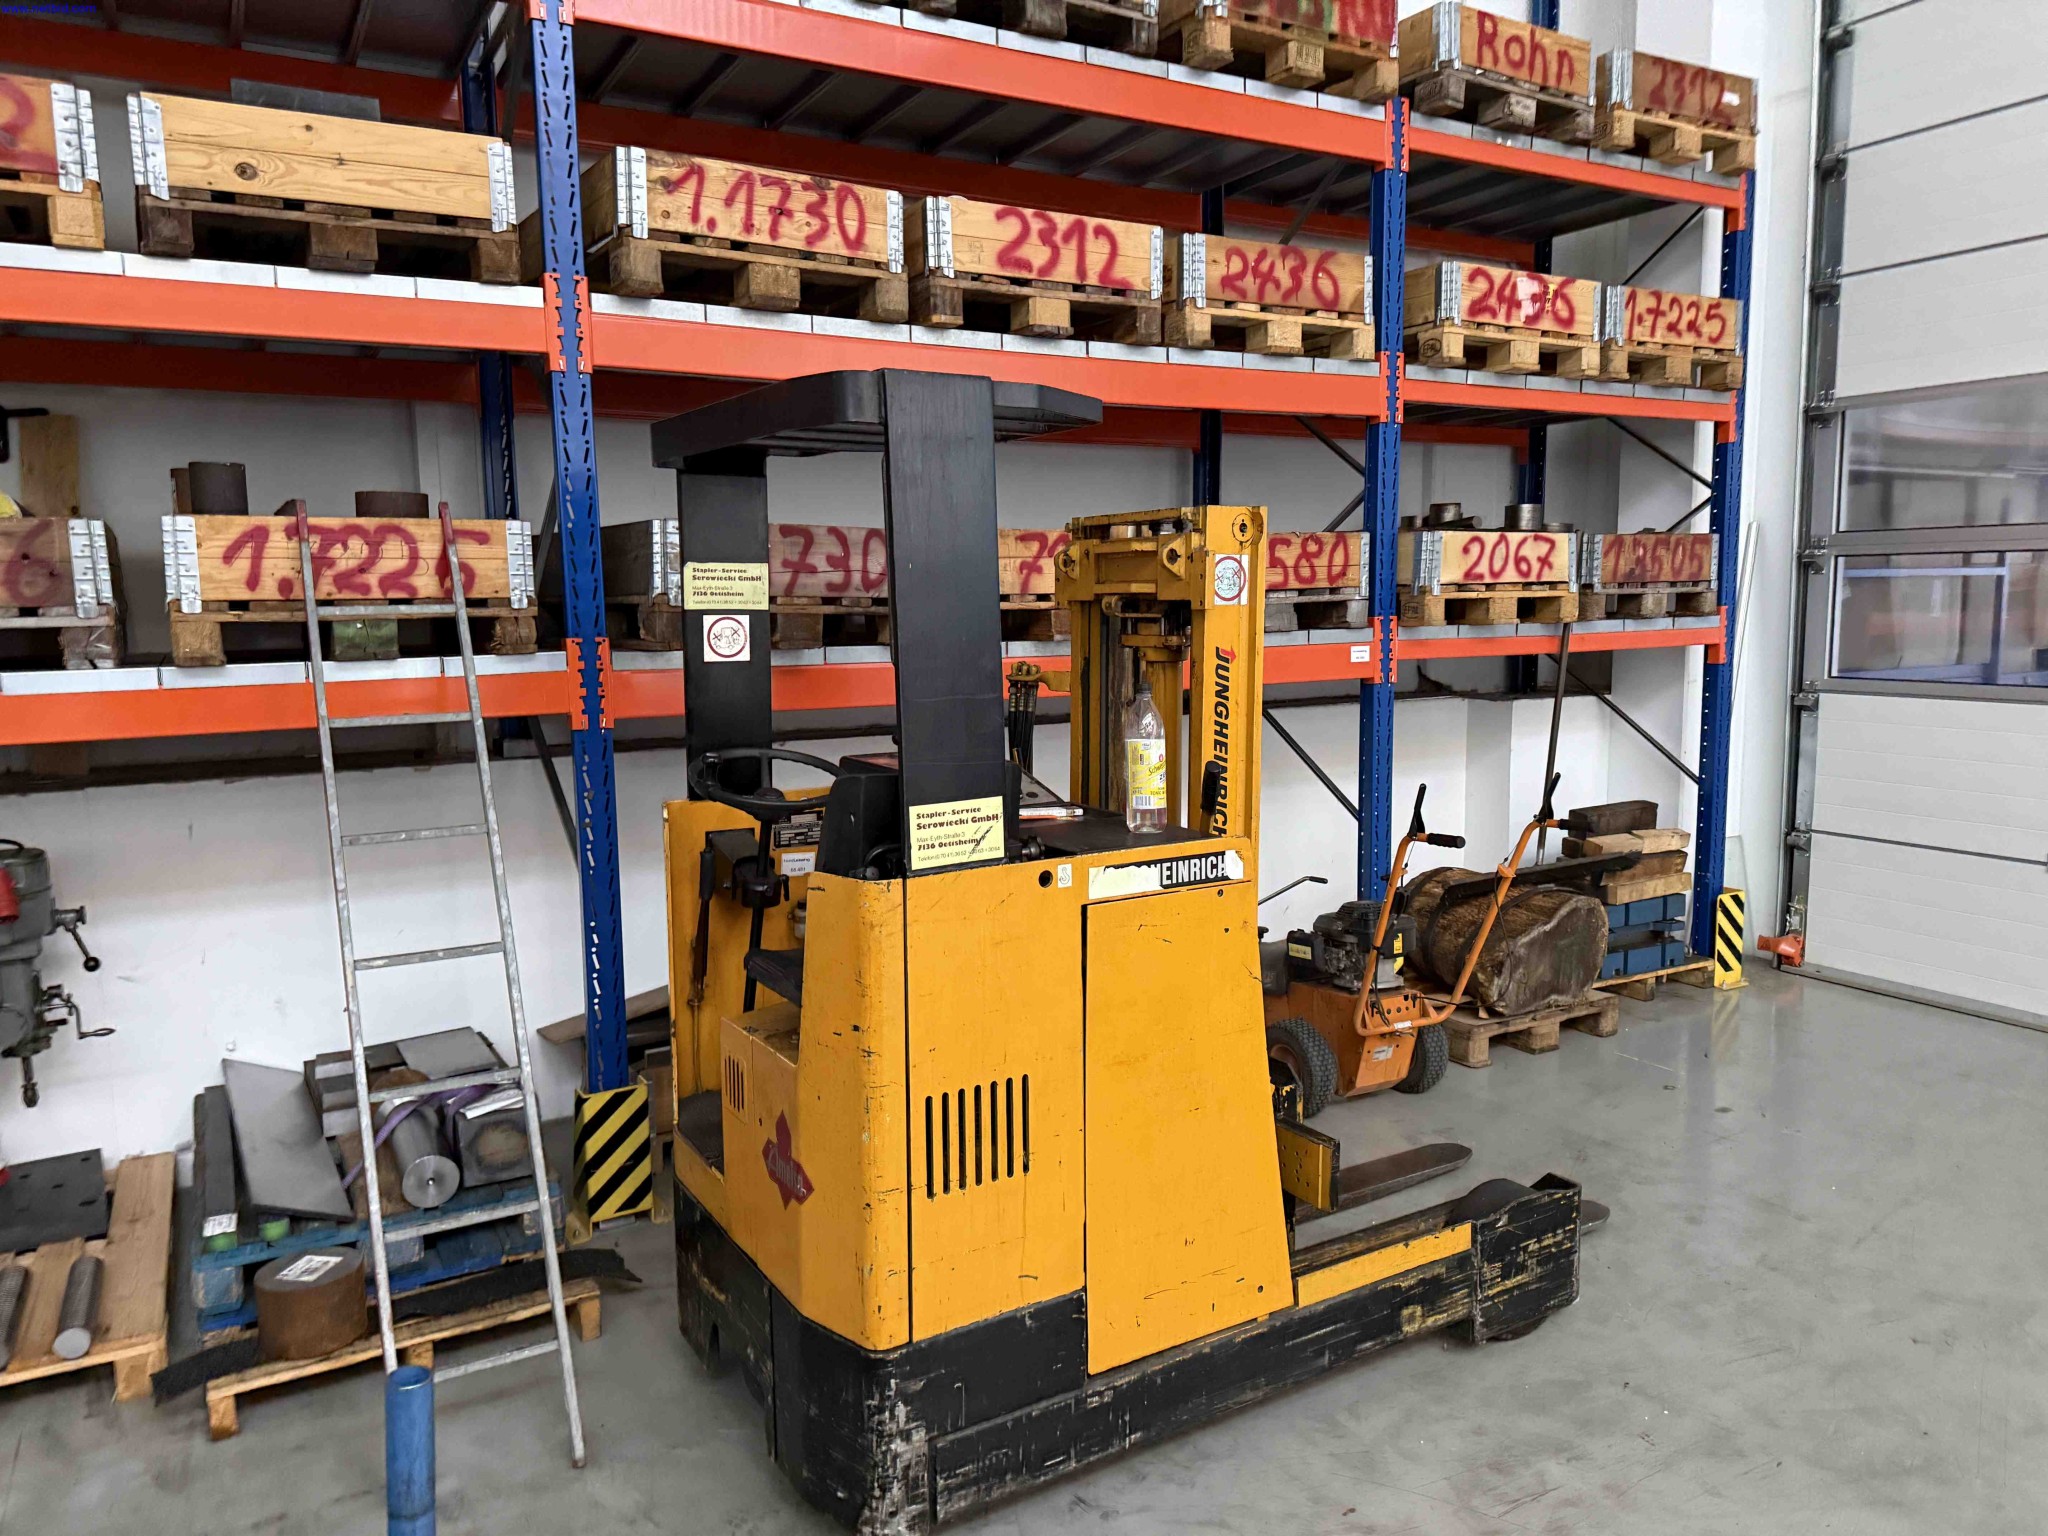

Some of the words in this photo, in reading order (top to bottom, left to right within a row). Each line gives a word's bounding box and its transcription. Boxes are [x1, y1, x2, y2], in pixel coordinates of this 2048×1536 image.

[1476, 10, 1574, 86] Rohn
[665, 164, 866, 253] 1.1730
[995, 206, 1134, 289] 2312
[1220, 245, 1340, 310] 2436
[1467, 266, 1576, 330] 2436
[1624, 288, 1726, 345] 1.7225
[1462, 532, 1556, 582] 2067
[916, 817, 969, 831] Serowiecki
[971, 813, 999, 824] GmbH
[917, 842, 936, 852] 7136
